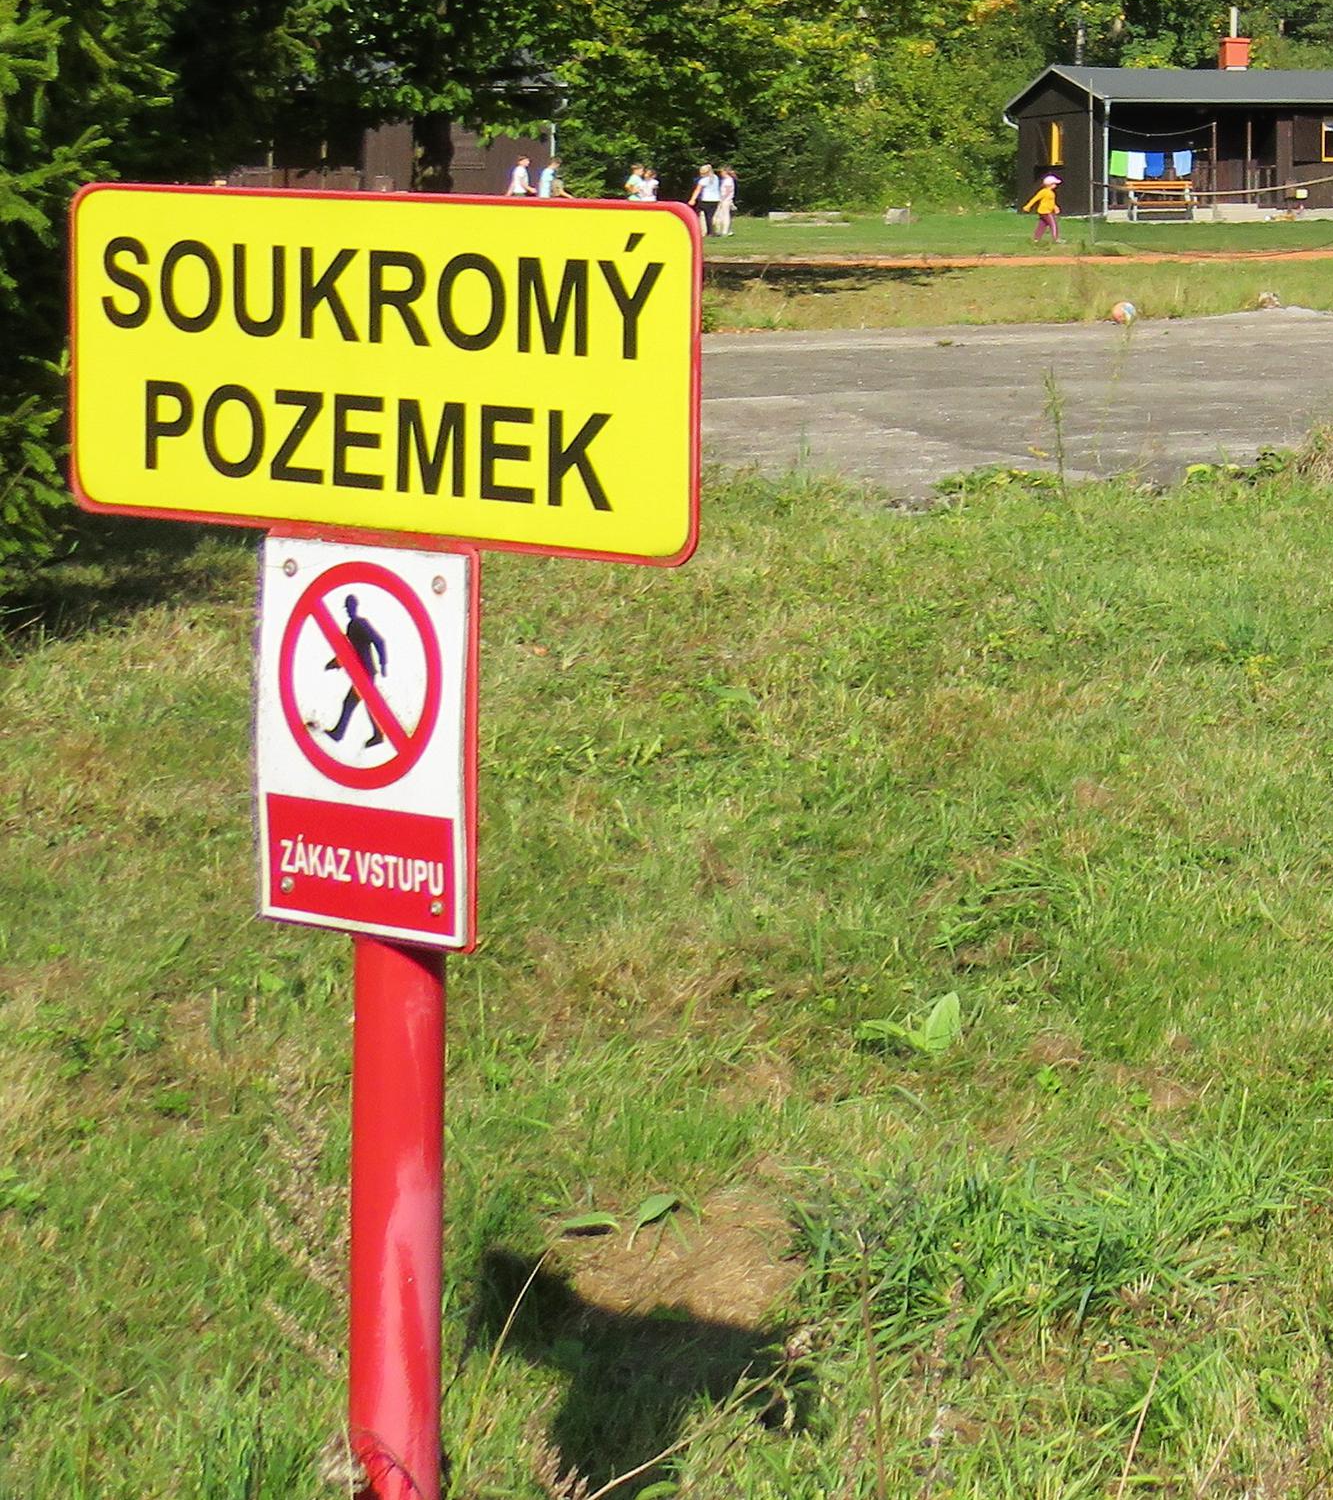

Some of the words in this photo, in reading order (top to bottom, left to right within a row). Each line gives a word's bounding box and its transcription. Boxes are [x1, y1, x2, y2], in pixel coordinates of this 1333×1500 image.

[102, 232, 664, 360] SOUKROMÝ
[145, 379, 612, 512] POZEMEK
[279, 833, 352, 883] ZÁKAZ
[354, 850, 444, 897] VSTUPU
